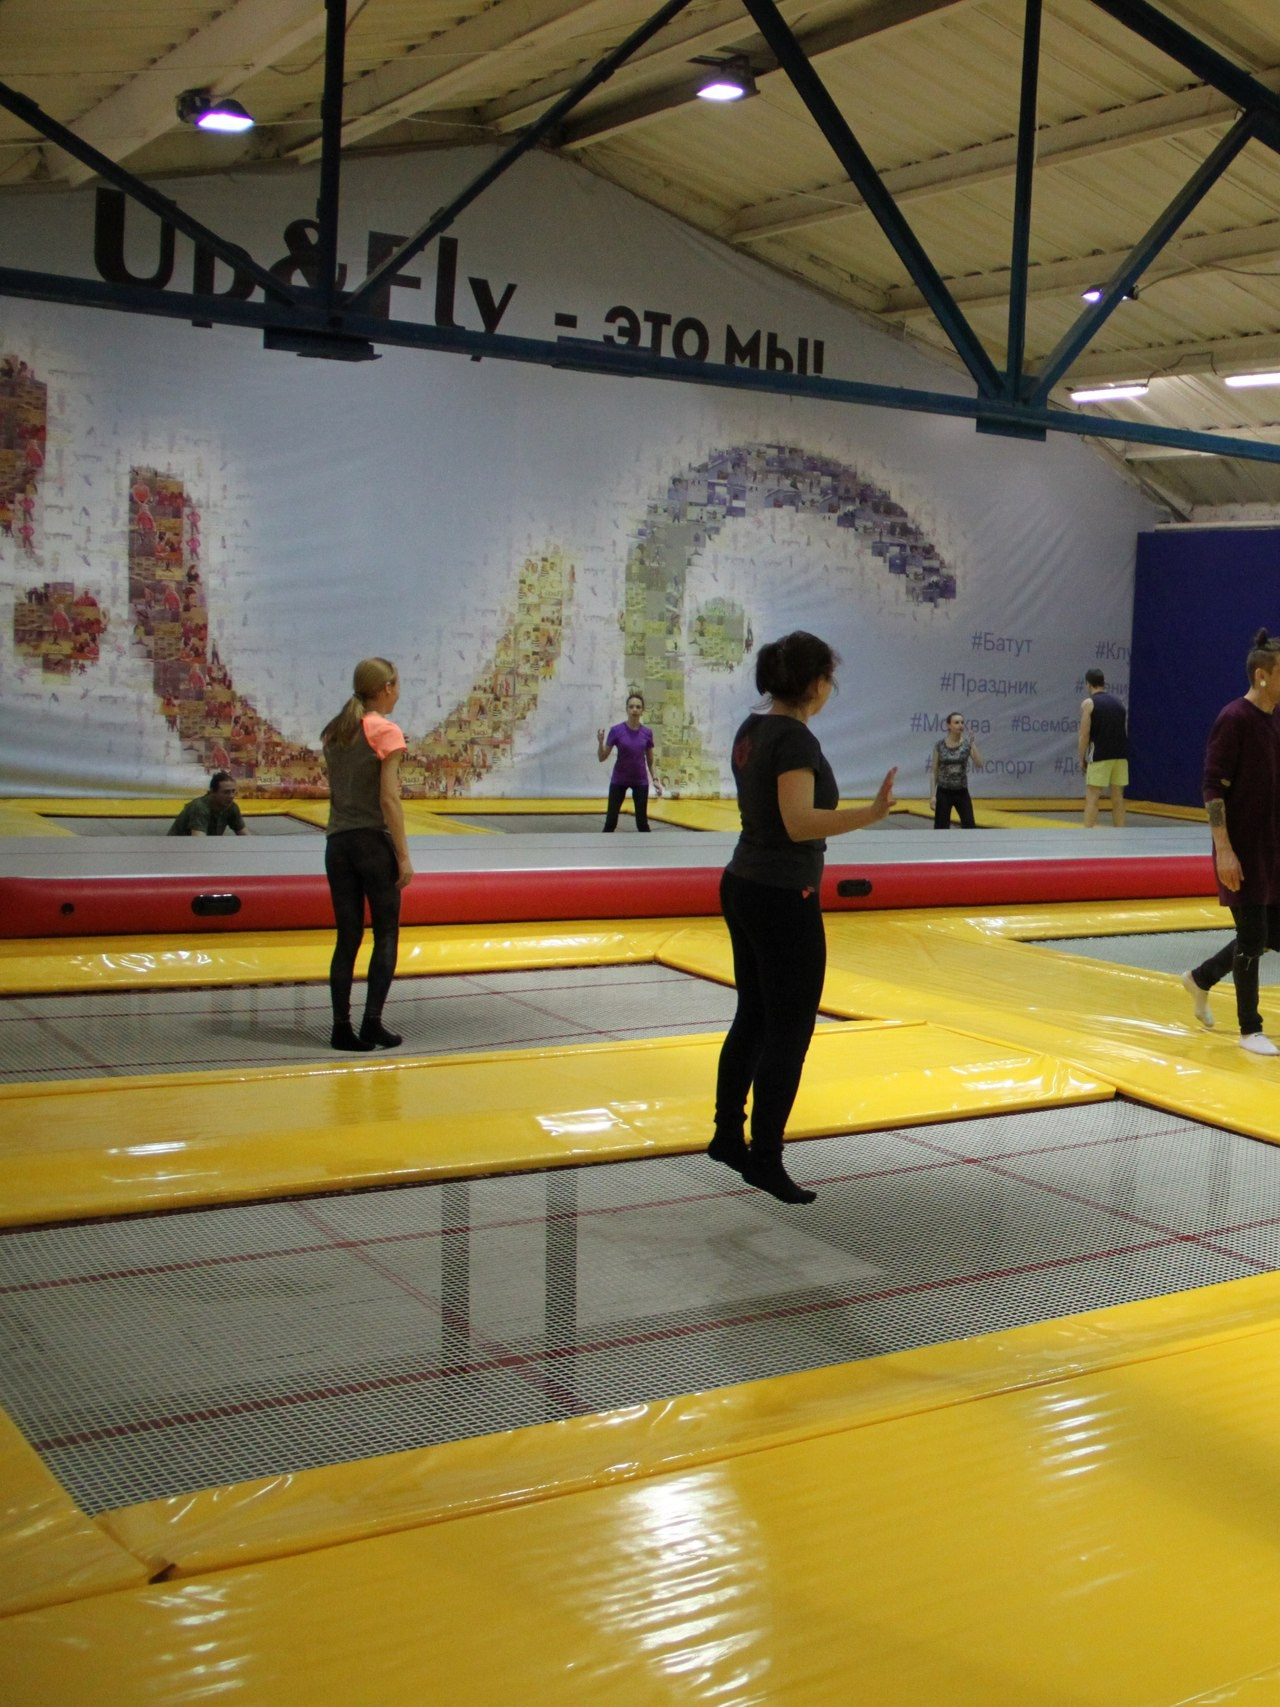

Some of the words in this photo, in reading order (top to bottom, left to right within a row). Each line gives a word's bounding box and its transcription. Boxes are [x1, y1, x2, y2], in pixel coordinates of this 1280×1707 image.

[971, 631, 1033, 657] #Батут
[940, 671, 1038, 697] #Праздник
[910, 712, 991, 734] #Моква
